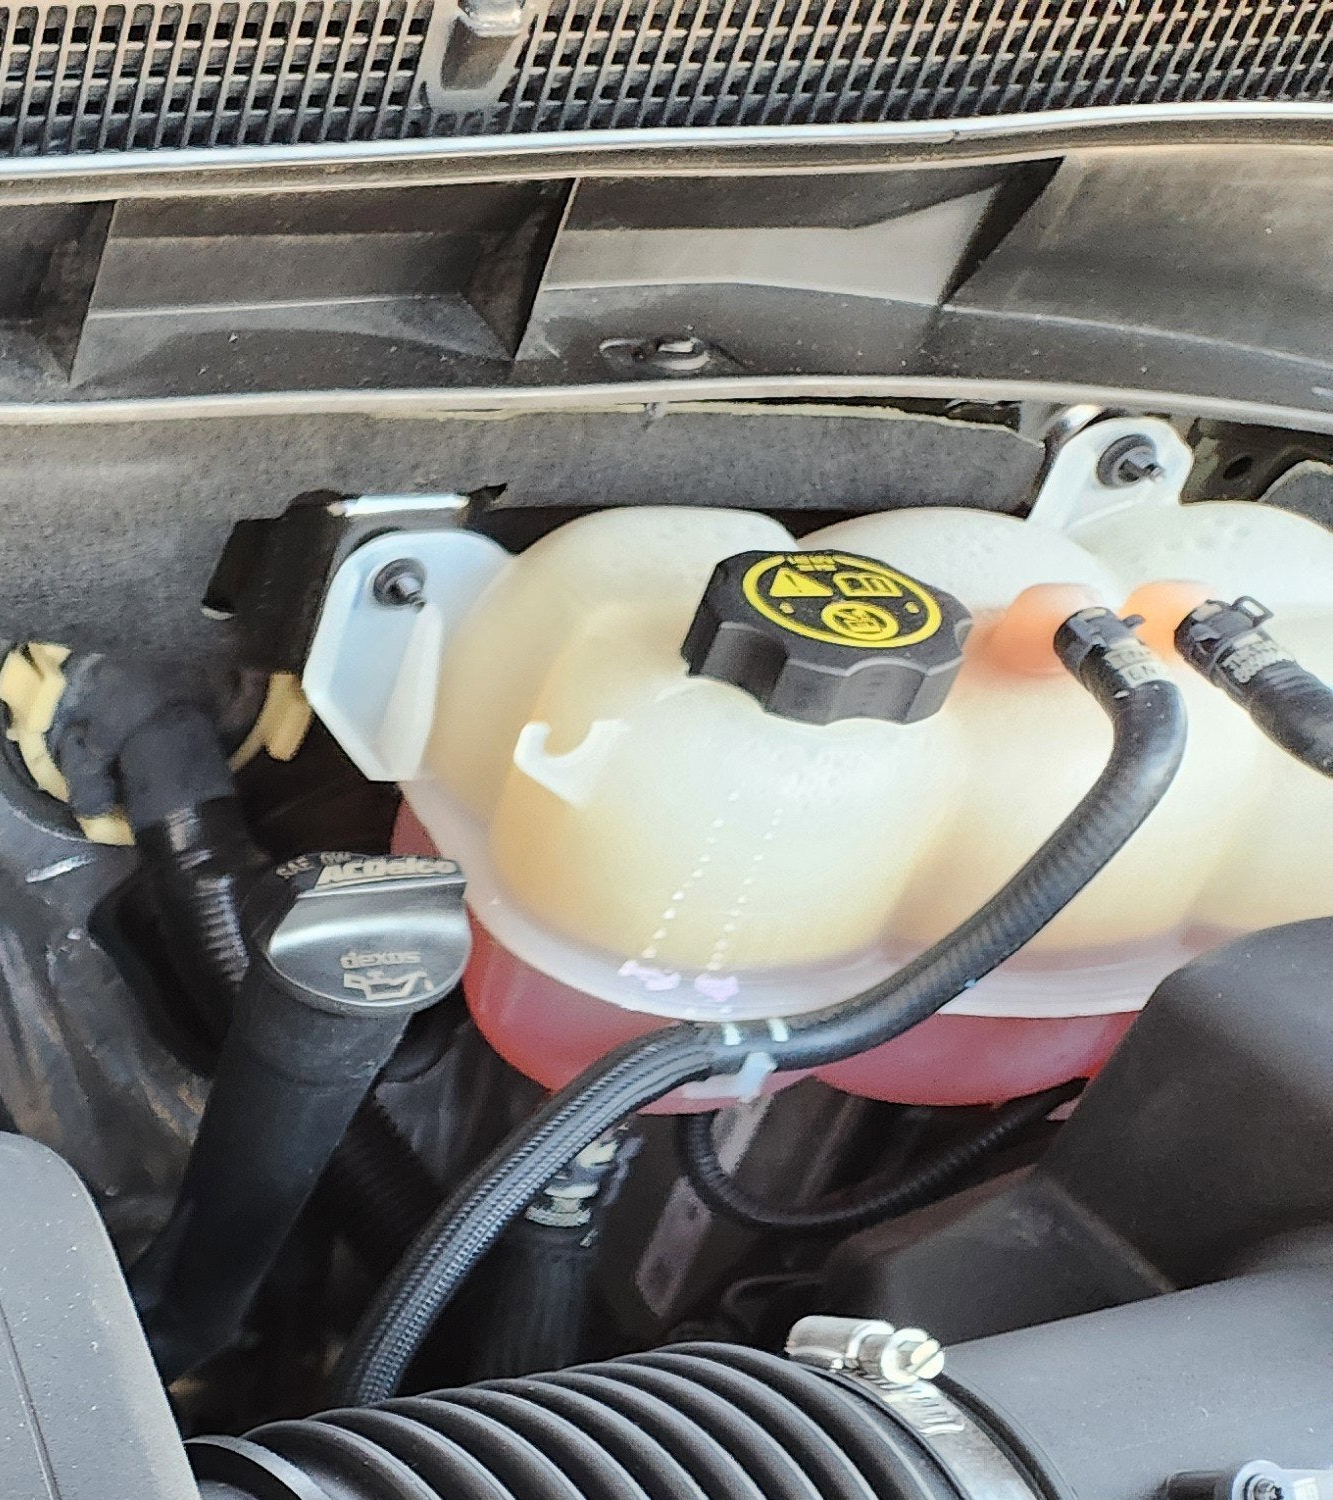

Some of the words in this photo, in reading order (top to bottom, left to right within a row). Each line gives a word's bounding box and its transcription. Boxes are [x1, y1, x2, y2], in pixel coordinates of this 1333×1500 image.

[276, 855, 314, 879] SAE
[317, 857, 459, 884] ACDelco
[340, 951, 421, 969] dexos
